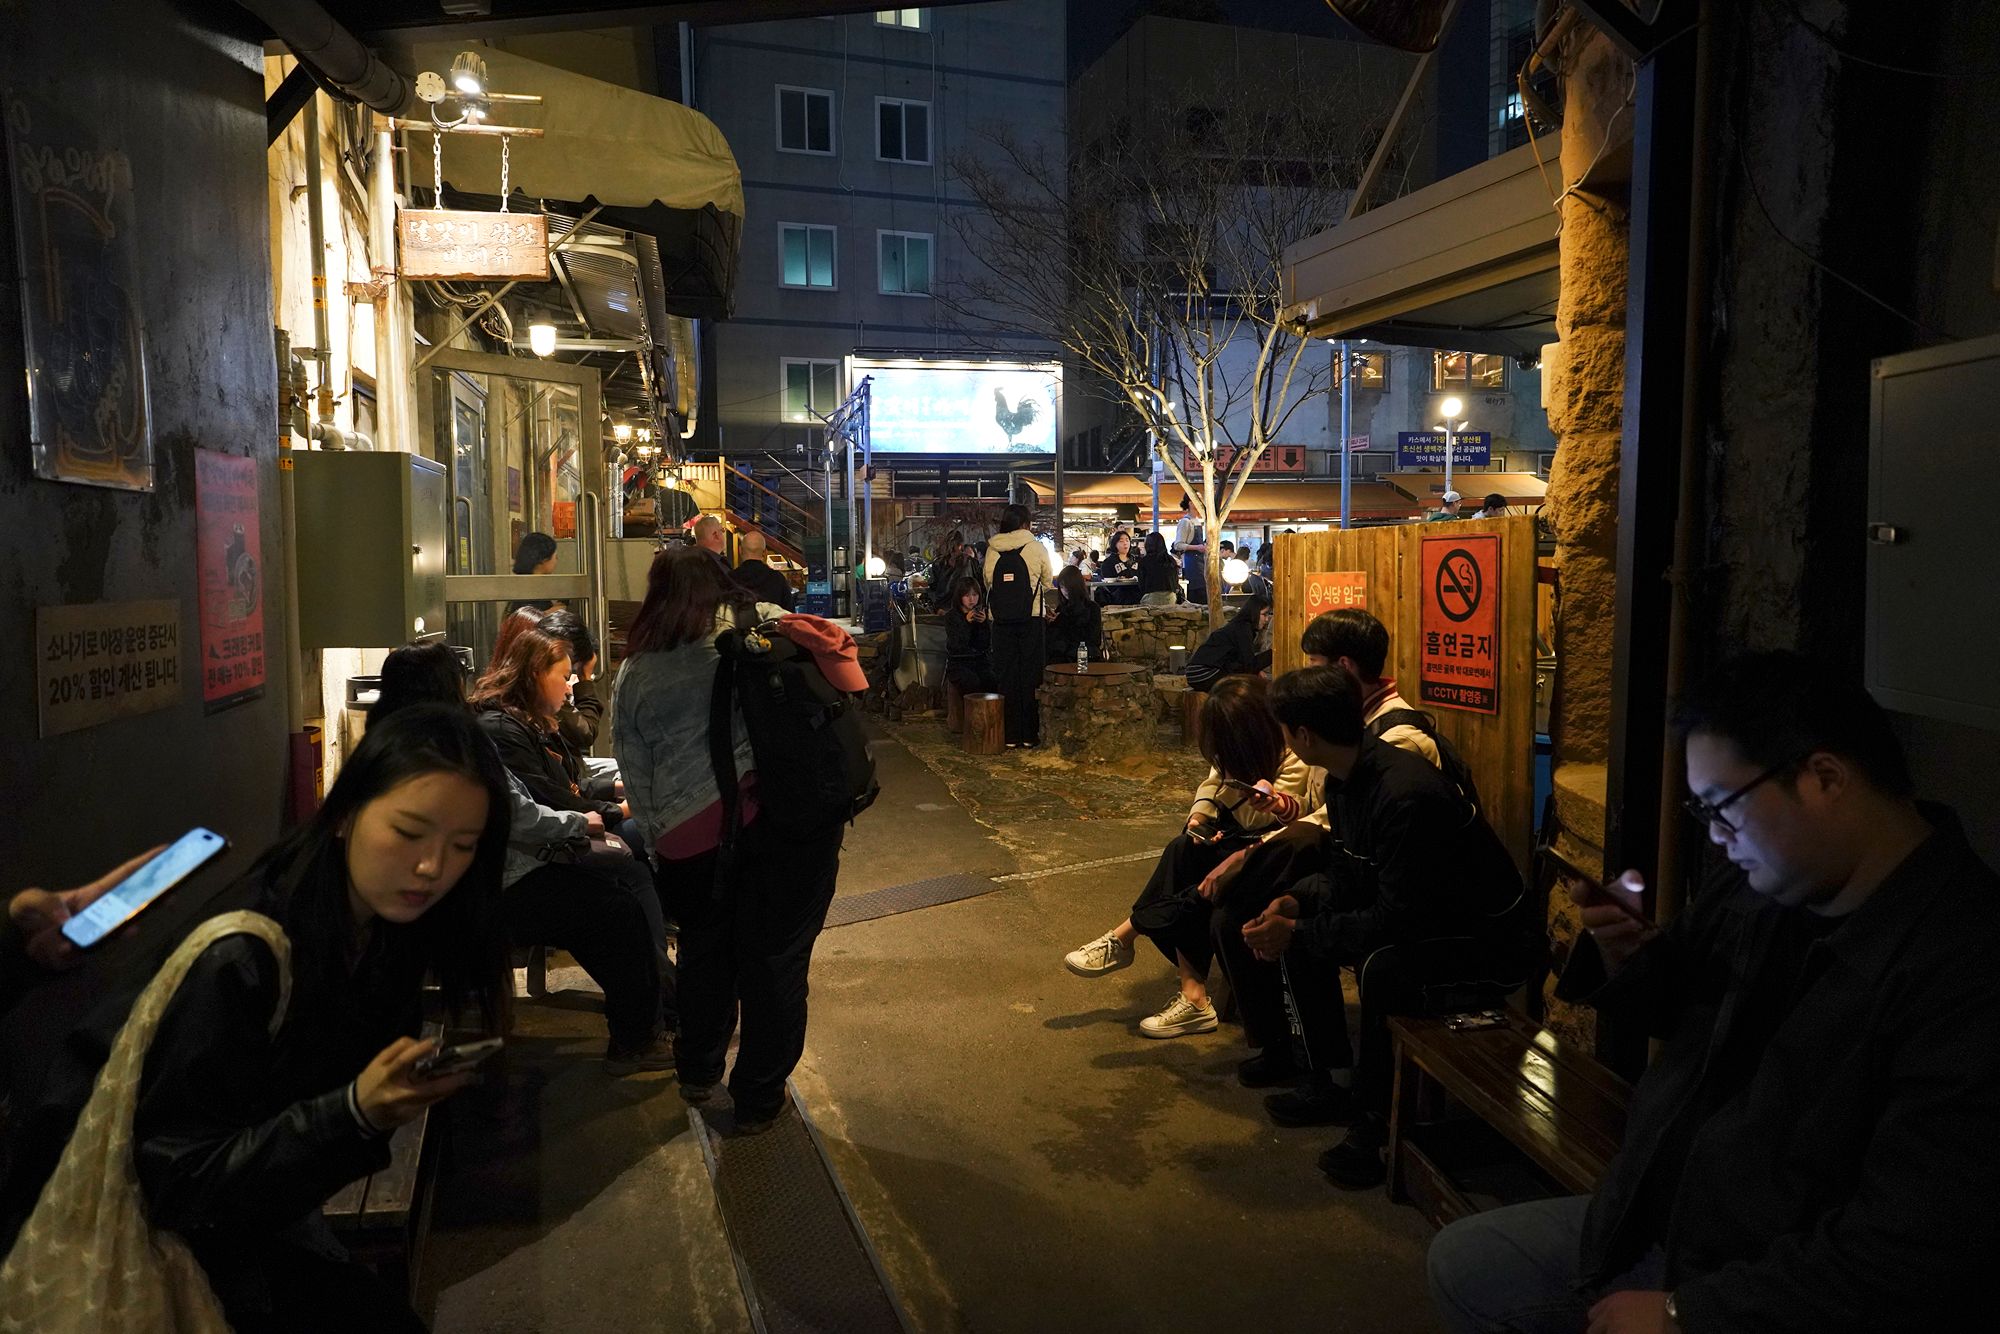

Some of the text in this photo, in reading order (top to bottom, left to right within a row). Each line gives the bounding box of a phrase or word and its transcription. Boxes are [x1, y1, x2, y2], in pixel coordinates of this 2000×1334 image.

[1323, 585, 1364, 605] 식당 입구
[47, 622, 176, 662] 소나기로 야장 운영 중단시
[1426, 631, 1491, 660] 흡연금지
[49, 673, 85, 706] 20%
[89, 665, 115, 700] 할인
[119, 661, 142, 692] 계산
[1434, 686, 1481, 704] CCTV 촬영중
